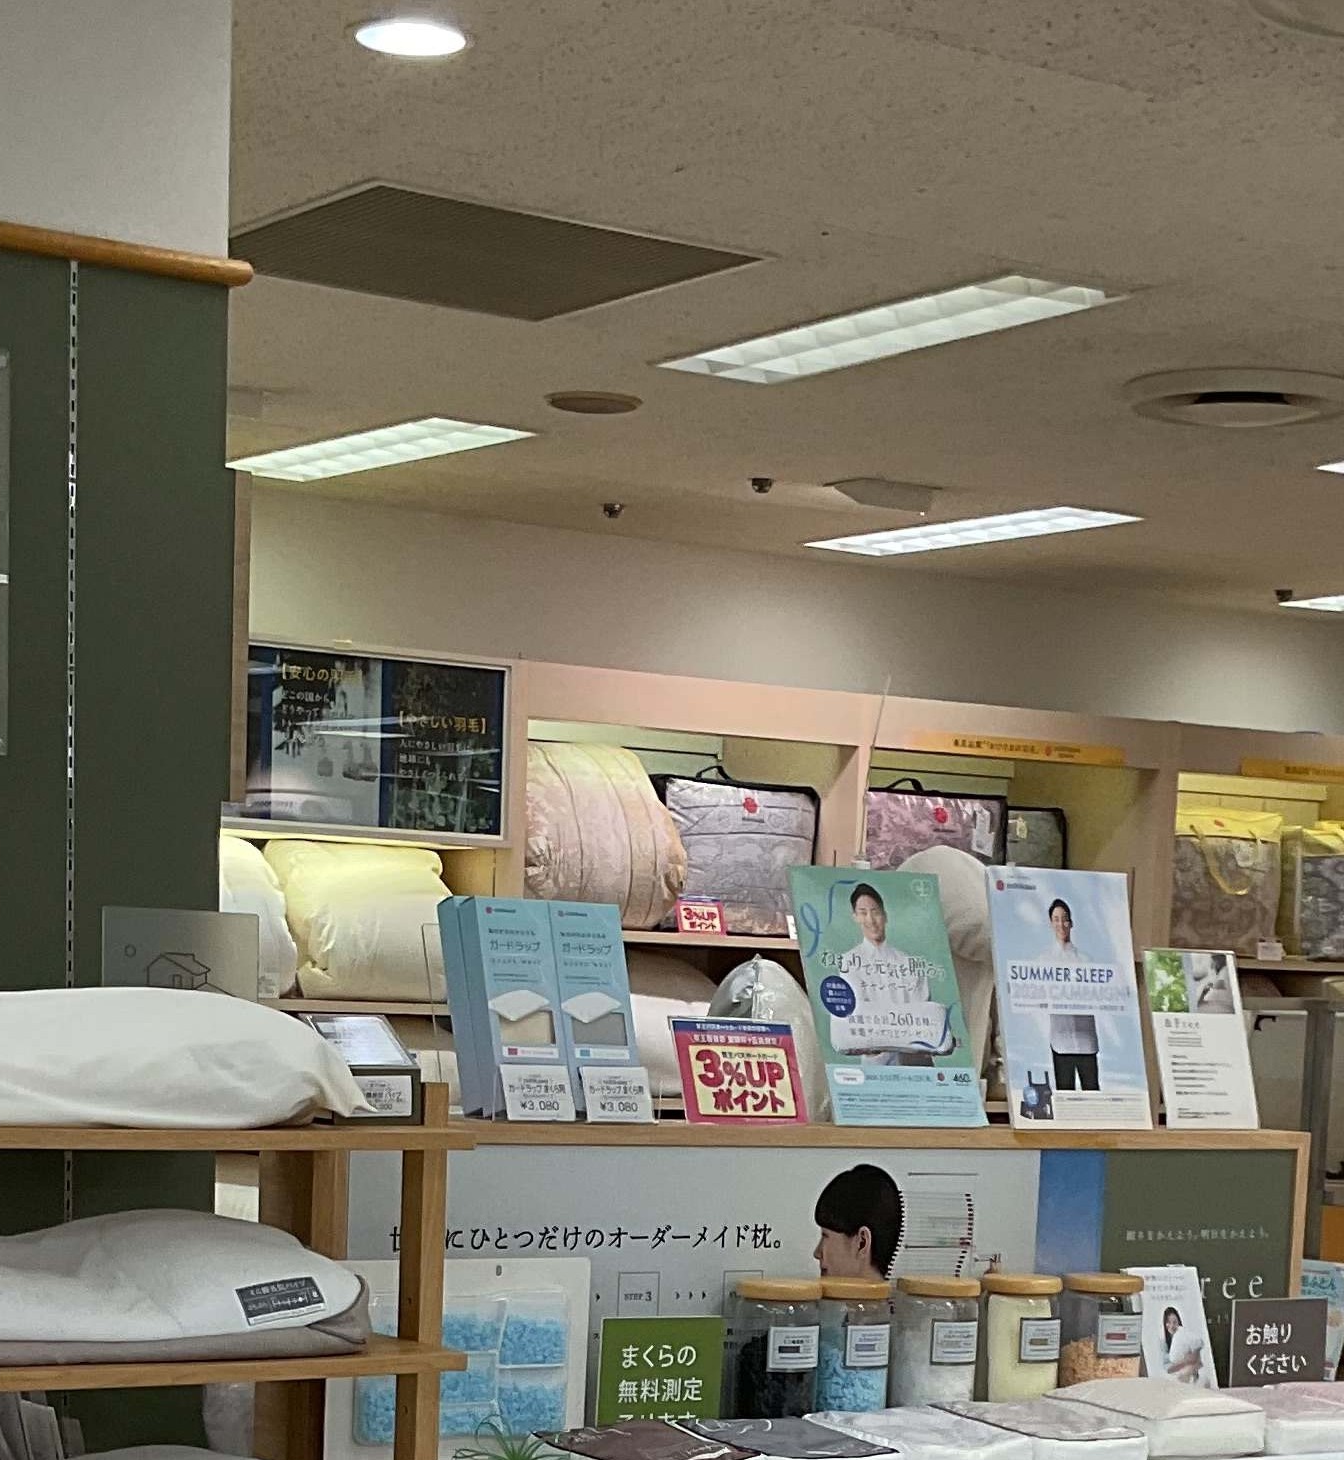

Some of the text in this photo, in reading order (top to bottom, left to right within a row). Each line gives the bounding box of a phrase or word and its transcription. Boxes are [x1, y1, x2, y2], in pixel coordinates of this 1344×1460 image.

[1010, 965, 1114, 984] SUMMER SLEEP
[695, 1050, 785, 1088] 3%UP
[713, 1089, 786, 1114] ポイント
[390, 1223, 784, 1251] にひとつだけのオーダーメイド枕。
[1246, 1323, 1292, 1345] お触り
[621, 1344, 696, 1369] まくらの
[1247, 1352, 1307, 1376] ください
[618, 1377, 703, 1403] 無料測定
